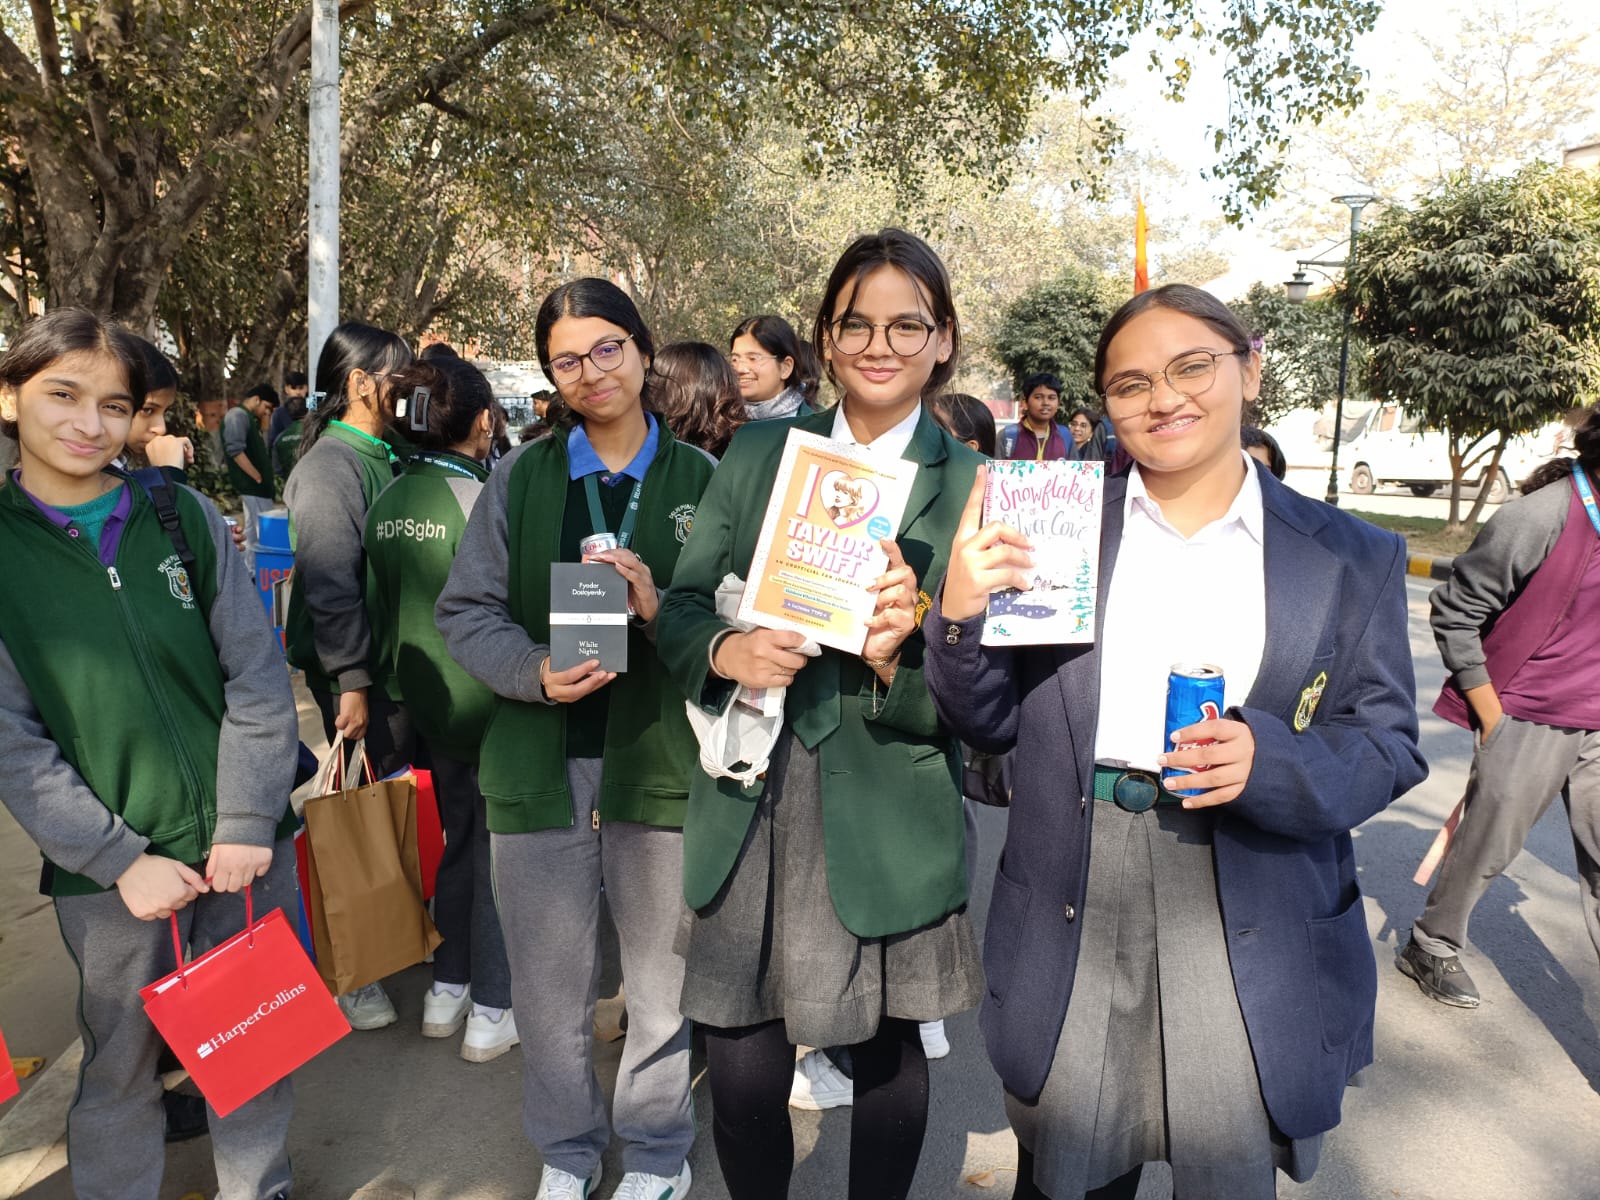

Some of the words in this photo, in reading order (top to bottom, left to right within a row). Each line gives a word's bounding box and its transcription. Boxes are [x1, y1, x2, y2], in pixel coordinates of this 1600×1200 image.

[797, 463, 821, 518] I
[1000, 475, 1095, 512] Snowflakes
[376, 518, 446, 541] #DPSgbn
[786, 517, 874, 562] TAYLOR
[1051, 510, 1088, 541] Cove
[785, 540, 862, 578] SWIFT
[578, 640, 598, 648] White
[578, 648, 599, 656] Nights
[210, 983, 306, 1050] HarperCollins
